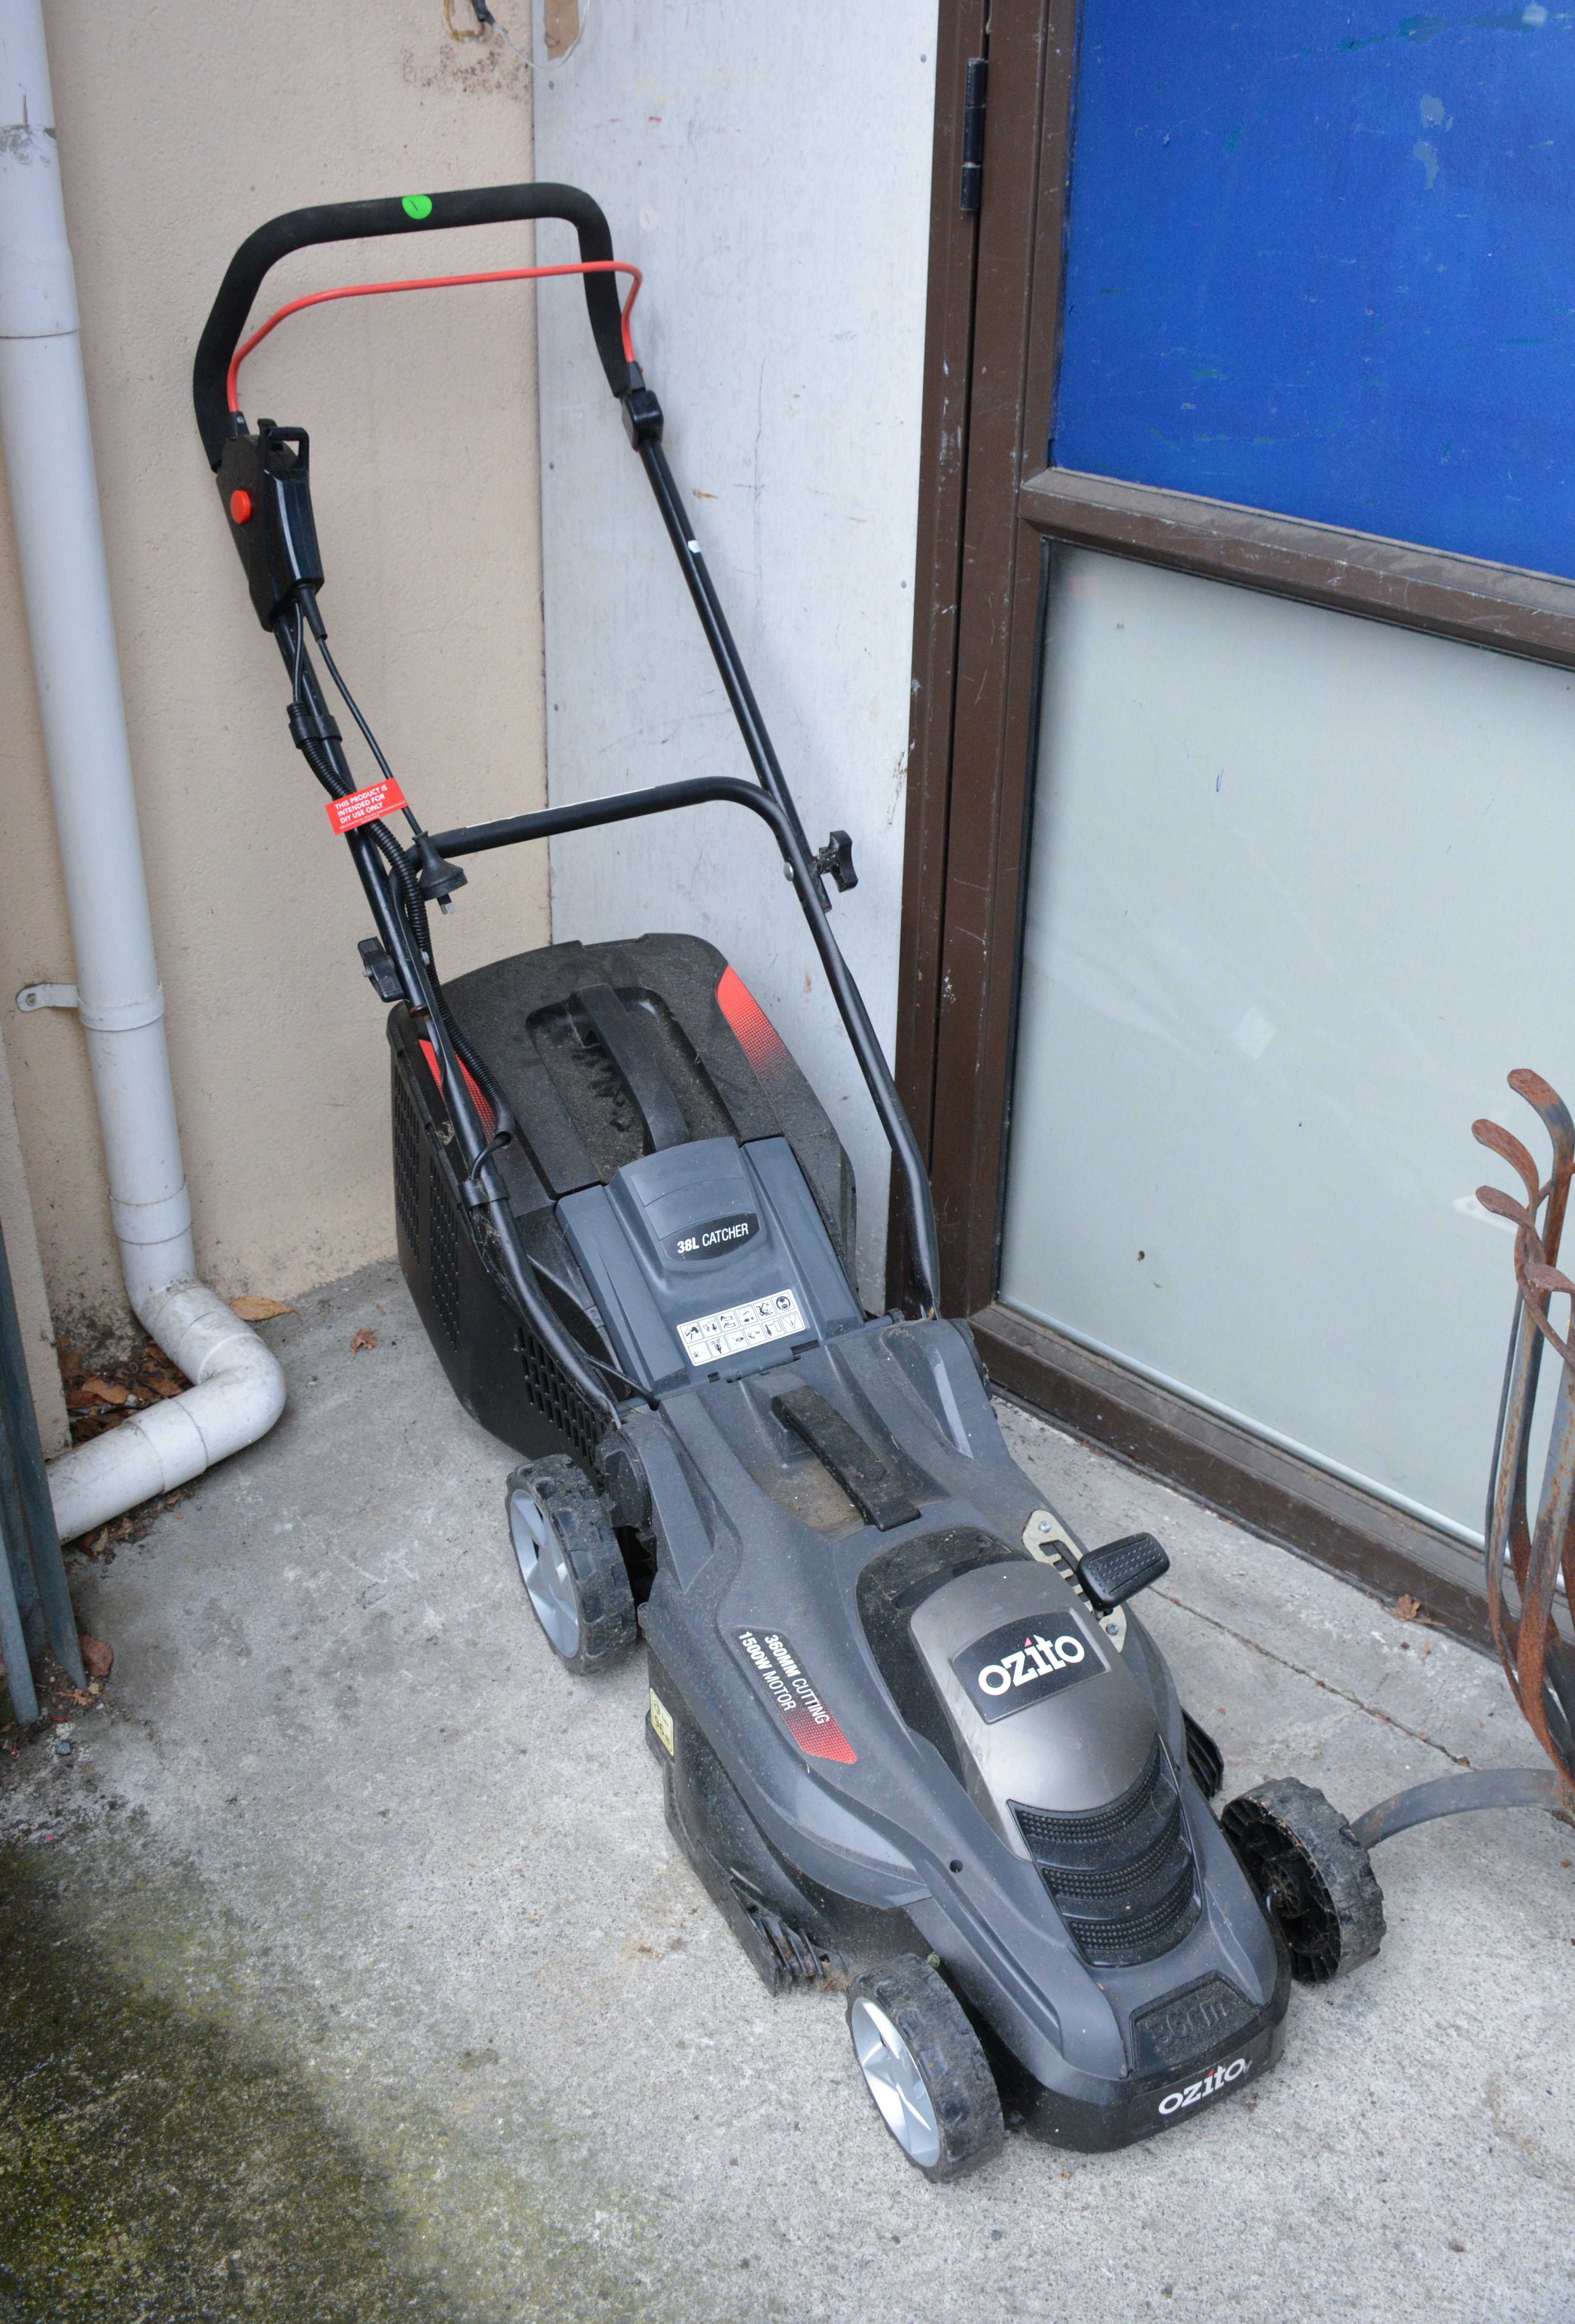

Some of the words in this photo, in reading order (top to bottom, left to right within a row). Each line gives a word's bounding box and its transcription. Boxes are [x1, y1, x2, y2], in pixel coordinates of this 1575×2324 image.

[334, 800, 349, 810] THIS
[350, 787, 380, 804] PRODUCT
[337, 800, 371, 817] INTENDED
[371, 794, 385, 803] FOR
[340, 815, 351, 824] DIY
[352, 809, 365, 819] USE
[365, 801, 383, 813] ONLY
[677, 1238, 699, 1254] 38L
[702, 1222, 749, 1247] CATCHER
[738, 1631, 773, 1670] 1500W
[762, 1670, 797, 1711] MOTOR
[764, 1634, 801, 1678] 360MM
[792, 1678, 830, 1724] CUTTING
